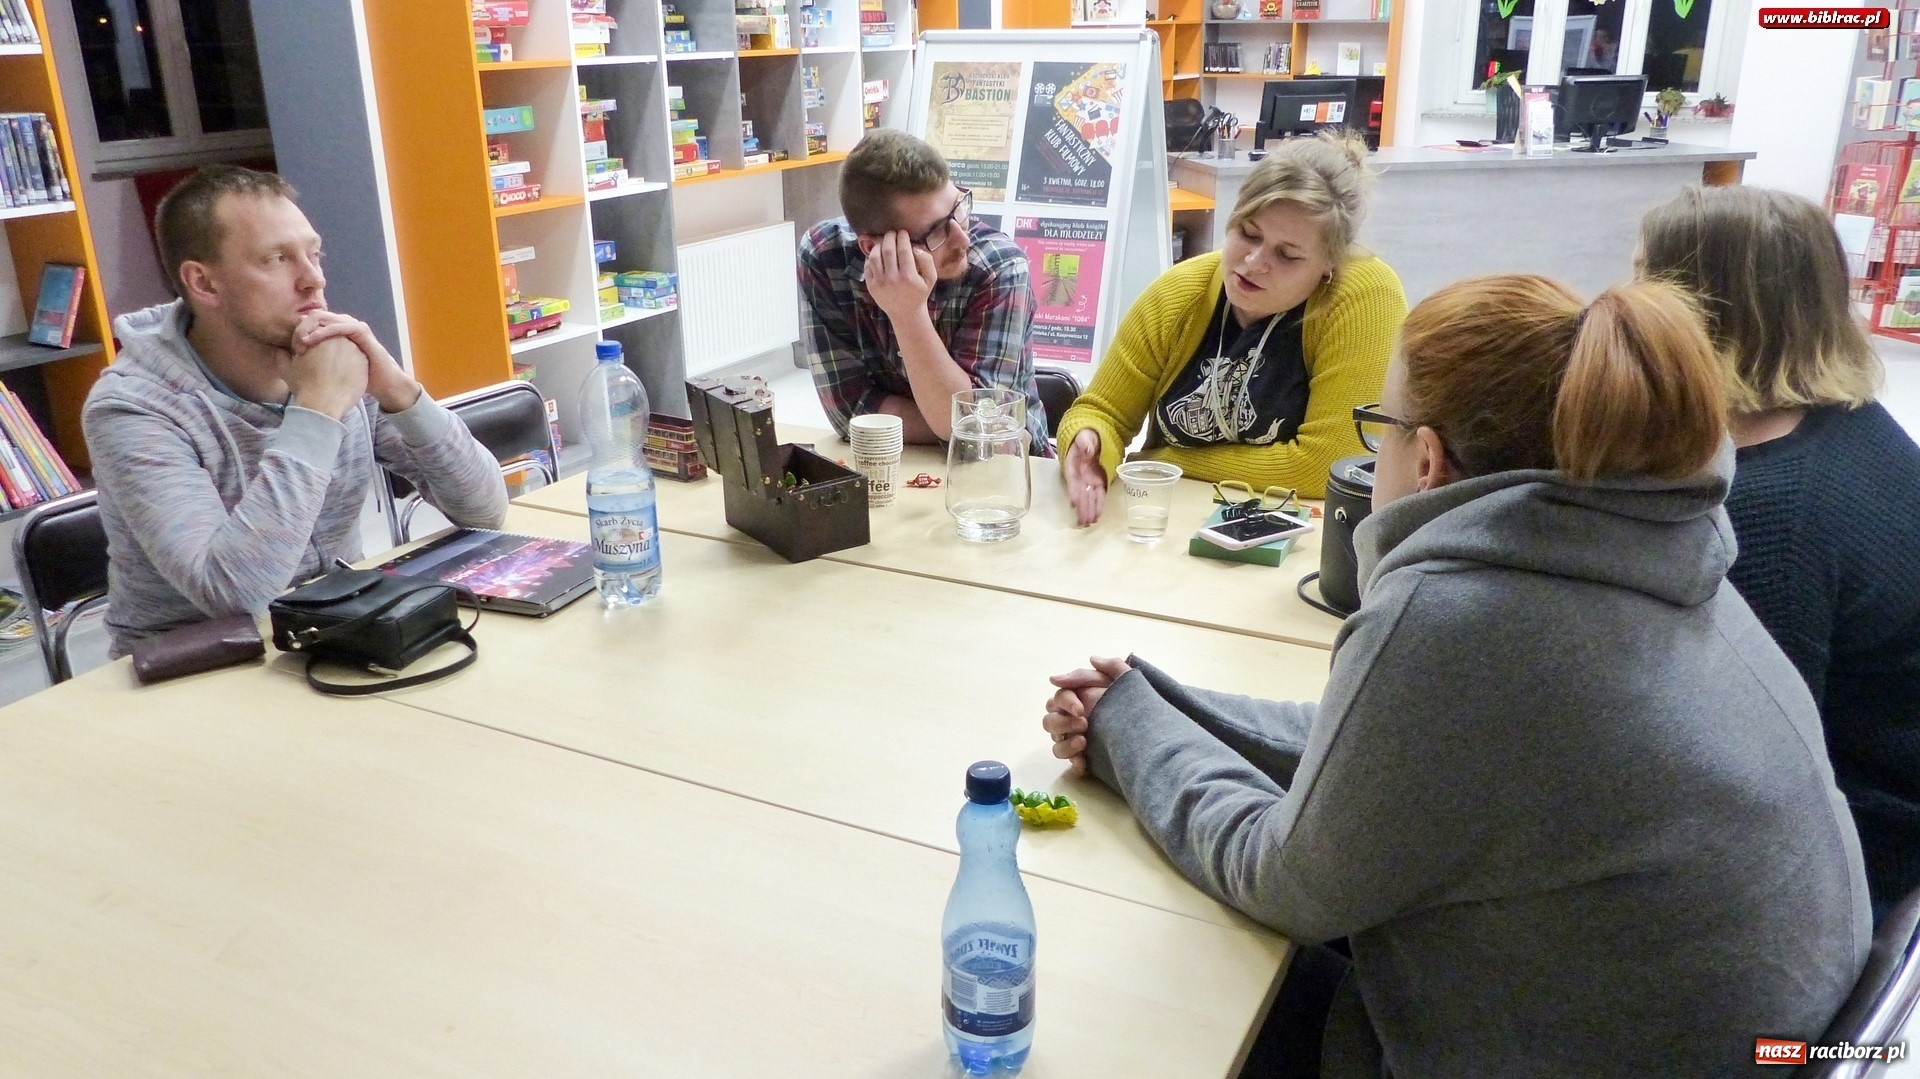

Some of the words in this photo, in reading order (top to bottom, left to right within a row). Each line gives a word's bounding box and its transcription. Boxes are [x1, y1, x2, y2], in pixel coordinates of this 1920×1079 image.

[965, 88, 1011, 101] BASTION
[1044, 128, 1062, 149] KLUB
[1058, 144, 1086, 176] FILMOWY
[1055, 119, 1096, 167] FANTASTYCZNY
[1044, 229, 1058, 238] DLA
[595, 517, 618, 529] Skarb
[620, 515, 644, 528] Życia
[592, 538, 650, 561] Muszyna
